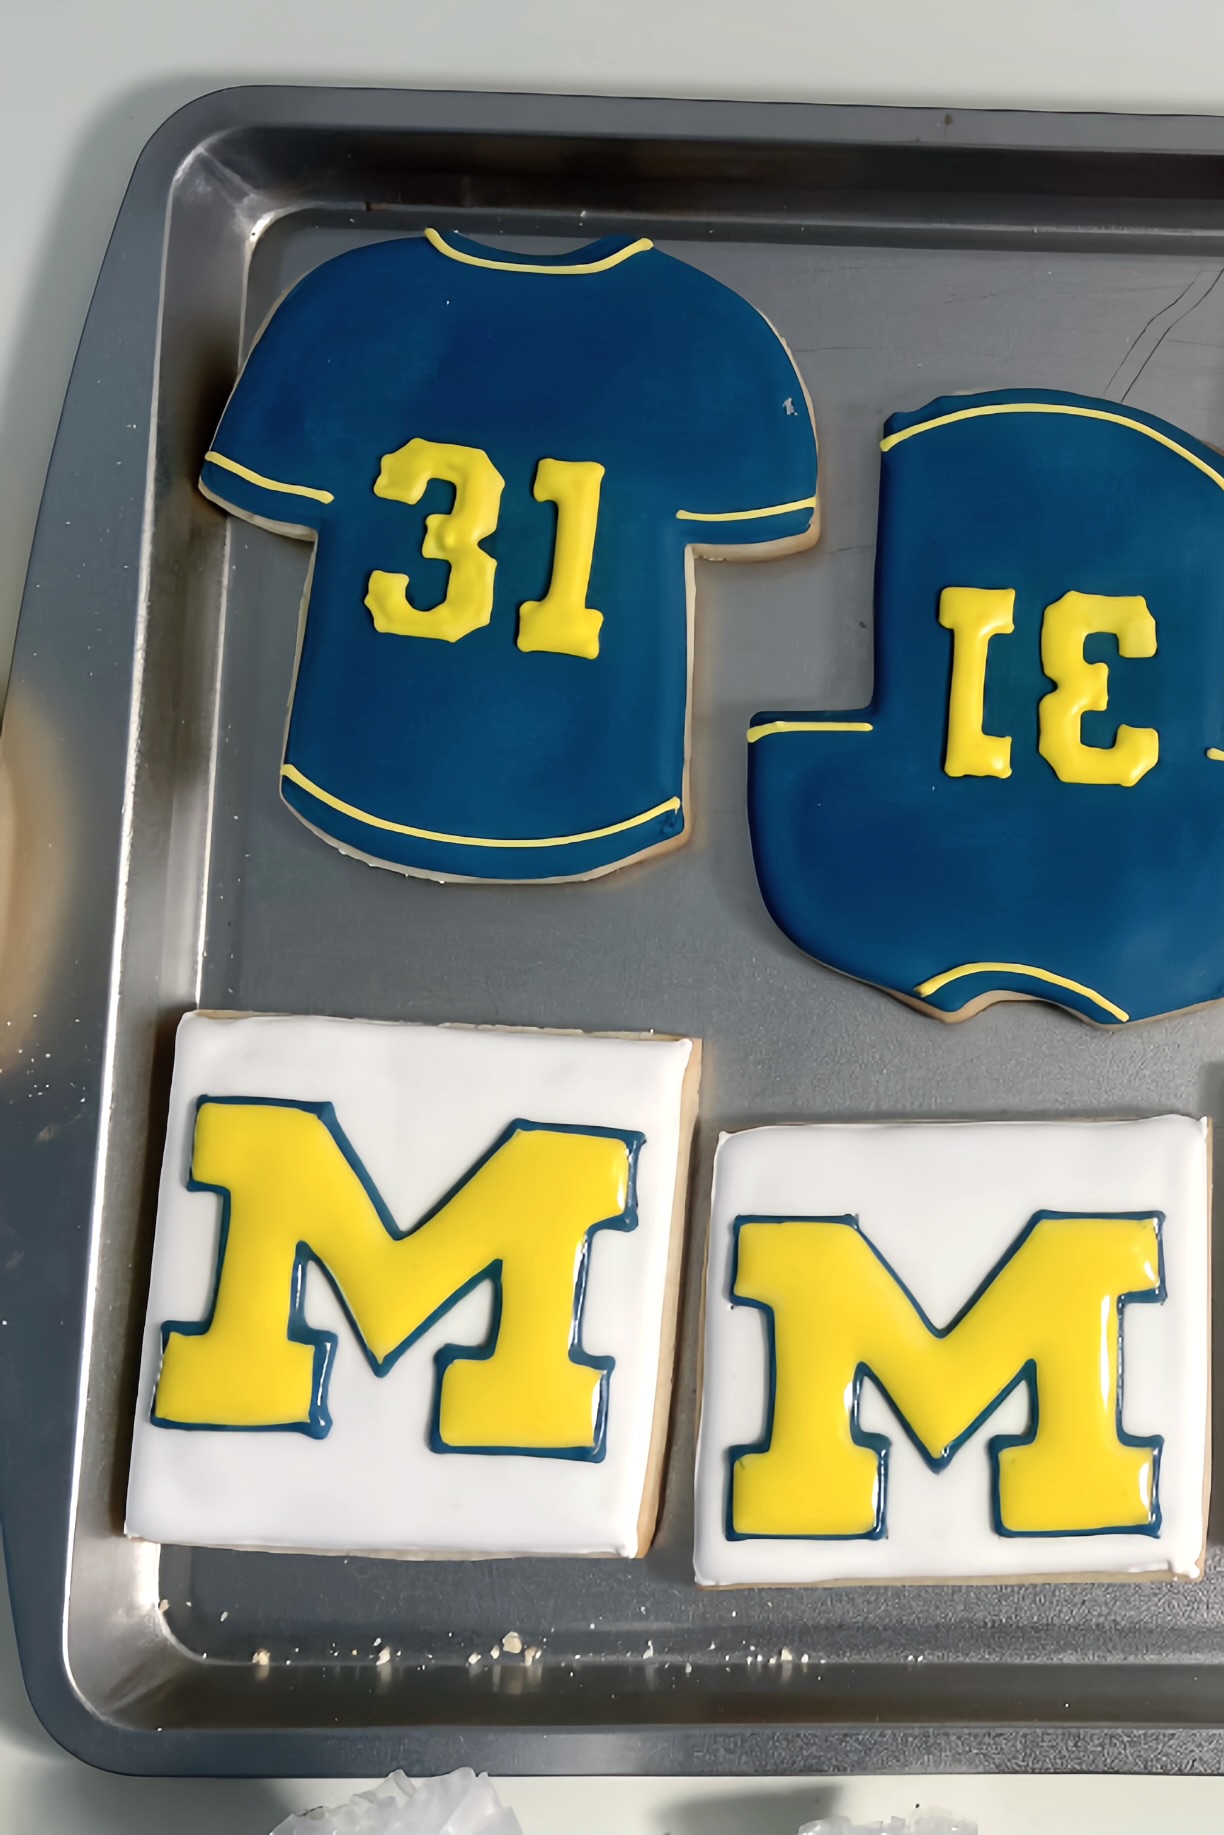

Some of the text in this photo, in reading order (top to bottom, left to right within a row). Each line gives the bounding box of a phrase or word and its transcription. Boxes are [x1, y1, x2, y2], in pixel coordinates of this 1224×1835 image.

[363, 438, 606, 660] 31
[938, 586, 1160, 788] 31
[150, 1095, 643, 1463] M
[727, 1211, 1166, 1540] M
